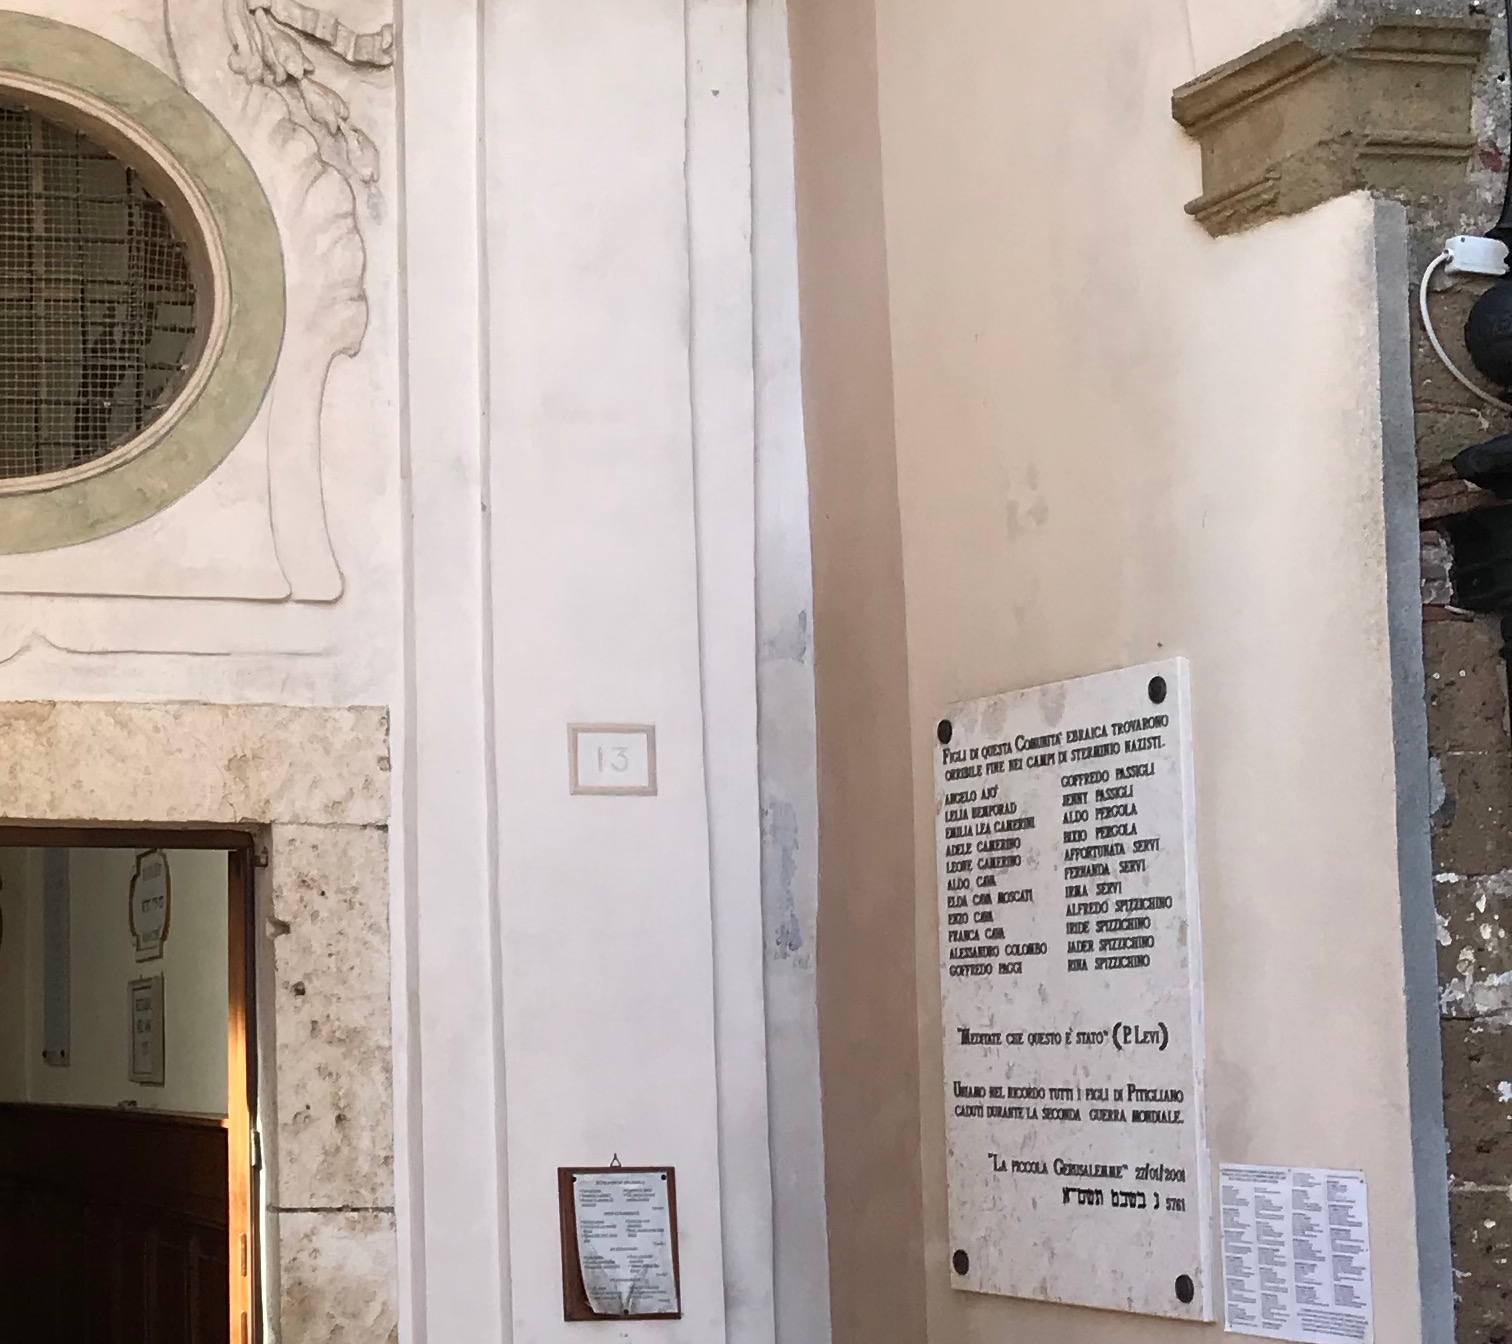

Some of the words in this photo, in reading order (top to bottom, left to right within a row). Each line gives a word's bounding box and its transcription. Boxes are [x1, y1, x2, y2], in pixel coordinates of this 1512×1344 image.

[970, 746, 979, 760] DI
[1066, 724, 1108, 743] EBRAICA
[1111, 714, 1170, 736] TROVARONO
[597, 747, 628, 772] 13
[945, 764, 983, 781] ORRIBILE
[986, 760, 1005, 775] FINE
[1008, 757, 1023, 772] NEI
[1026, 751, 1056, 769] CAMPI
[1058, 750, 1068, 764] DI
[1070, 741, 1120, 763] STERMINIO
[1061, 769, 1109, 788] GOFFREDO
[1115, 762, 1155, 781] PASSIGLI
[1095, 785, 1134, 803] PASSIGLI
[945, 808, 969, 823] LELIA
[1062, 809, 1089, 825] ALDO
[1095, 803, 1138, 820] PERGOLA
[945, 824, 973, 840] EMILIA
[975, 822, 991, 836] LEA
[1095, 823, 1138, 841] PERGOLA
[945, 842, 972, 858] ADELE
[1132, 838, 1160, 853] SERVI
[946, 859, 973, 874] LEONE
[1119, 859, 1146, 874] SERVI
[947, 876, 970, 891] ALDO
[1096, 881, 1123, 896] SERVI
[1065, 899, 1109, 917] ALFREDO
[1114, 895, 1173, 913] SPIZZICHINO
[1095, 916, 1152, 933] SPIZZICHINO
[949, 944, 1000, 960] ALESSANDRO
[1004, 942, 1048, 956] COLOMBO
[1098, 934, 1155, 952] SPIZZICHINO
[949, 962, 993, 977] GOFFREDO
[1094, 954, 1151, 971] SPIZZICHINO
[1027, 1032, 1062, 1047] QUESTO
[1048, 1086, 1074, 1101] TUTTI
[1085, 1087, 1109, 1102] FIGLI
[1113, 1088, 1123, 1102] DI
[1127, 1083, 1184, 1103] PITIGLIANO
[986, 1105, 1025, 1119] DURANTE
[1025, 1106, 1038, 1120] LA
[1041, 1107, 1081, 1121] SECONDA
[1088, 1107, 1127, 1122] GUERRA
[1165, 1198, 1186, 1212] 5761
